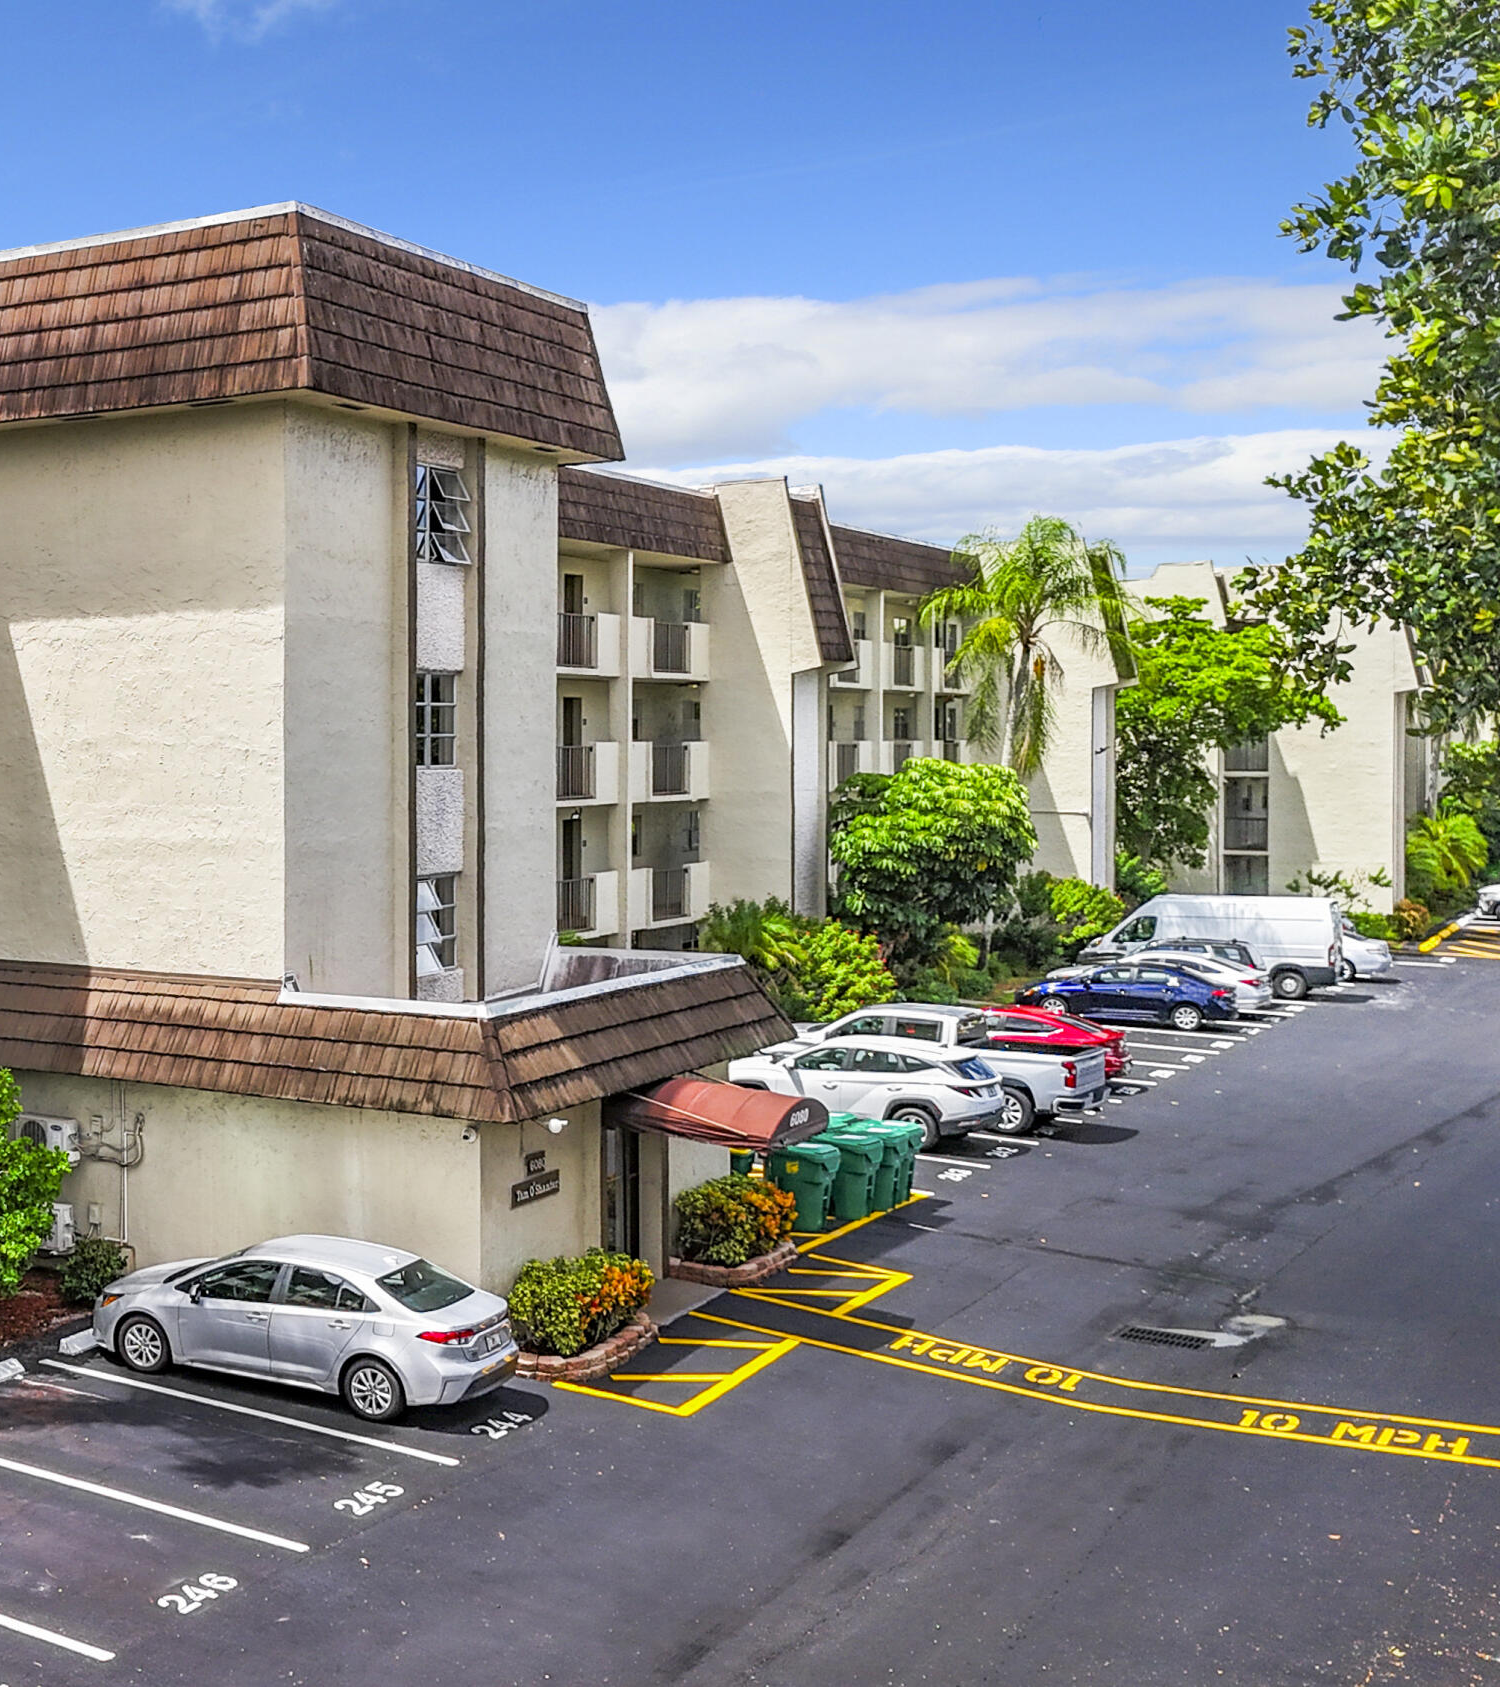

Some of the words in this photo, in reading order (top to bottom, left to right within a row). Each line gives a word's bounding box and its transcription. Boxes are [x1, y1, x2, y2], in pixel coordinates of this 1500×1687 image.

[789, 1107, 810, 1128] 6080
[888, 1334, 1011, 1374] MPH
[1024, 1366, 1083, 1392] 10
[470, 1410, 534, 1440] 244
[1238, 1409, 1301, 1432] 10
[1330, 1421, 1471, 1456] MPH
[333, 1480, 405, 1516] 245
[156, 1572, 239, 1615] 246
